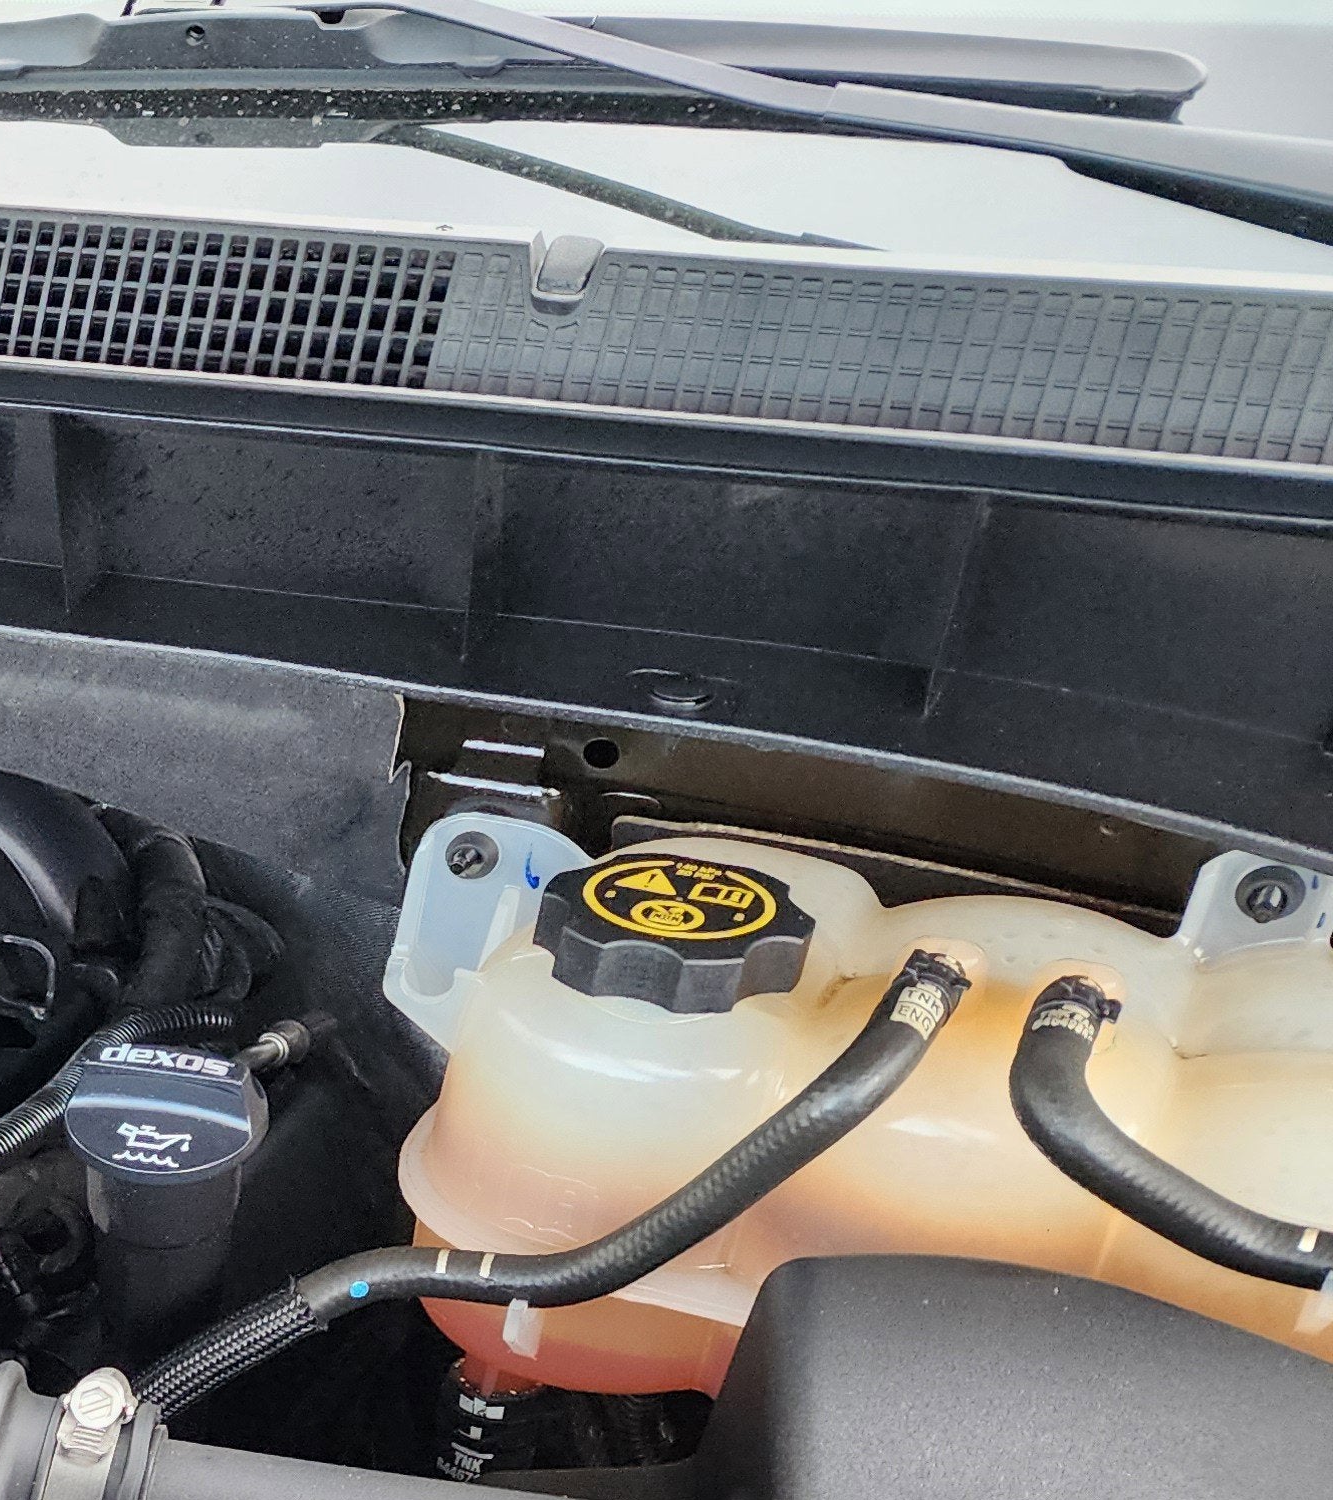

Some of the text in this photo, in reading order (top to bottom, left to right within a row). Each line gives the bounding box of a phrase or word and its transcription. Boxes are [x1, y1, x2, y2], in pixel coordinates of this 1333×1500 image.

[907, 988, 941, 1015] TNK
[898, 1004, 930, 1031] ENG
[99, 1042, 233, 1077] dexos
[454, 1452, 483, 1473] TNK
